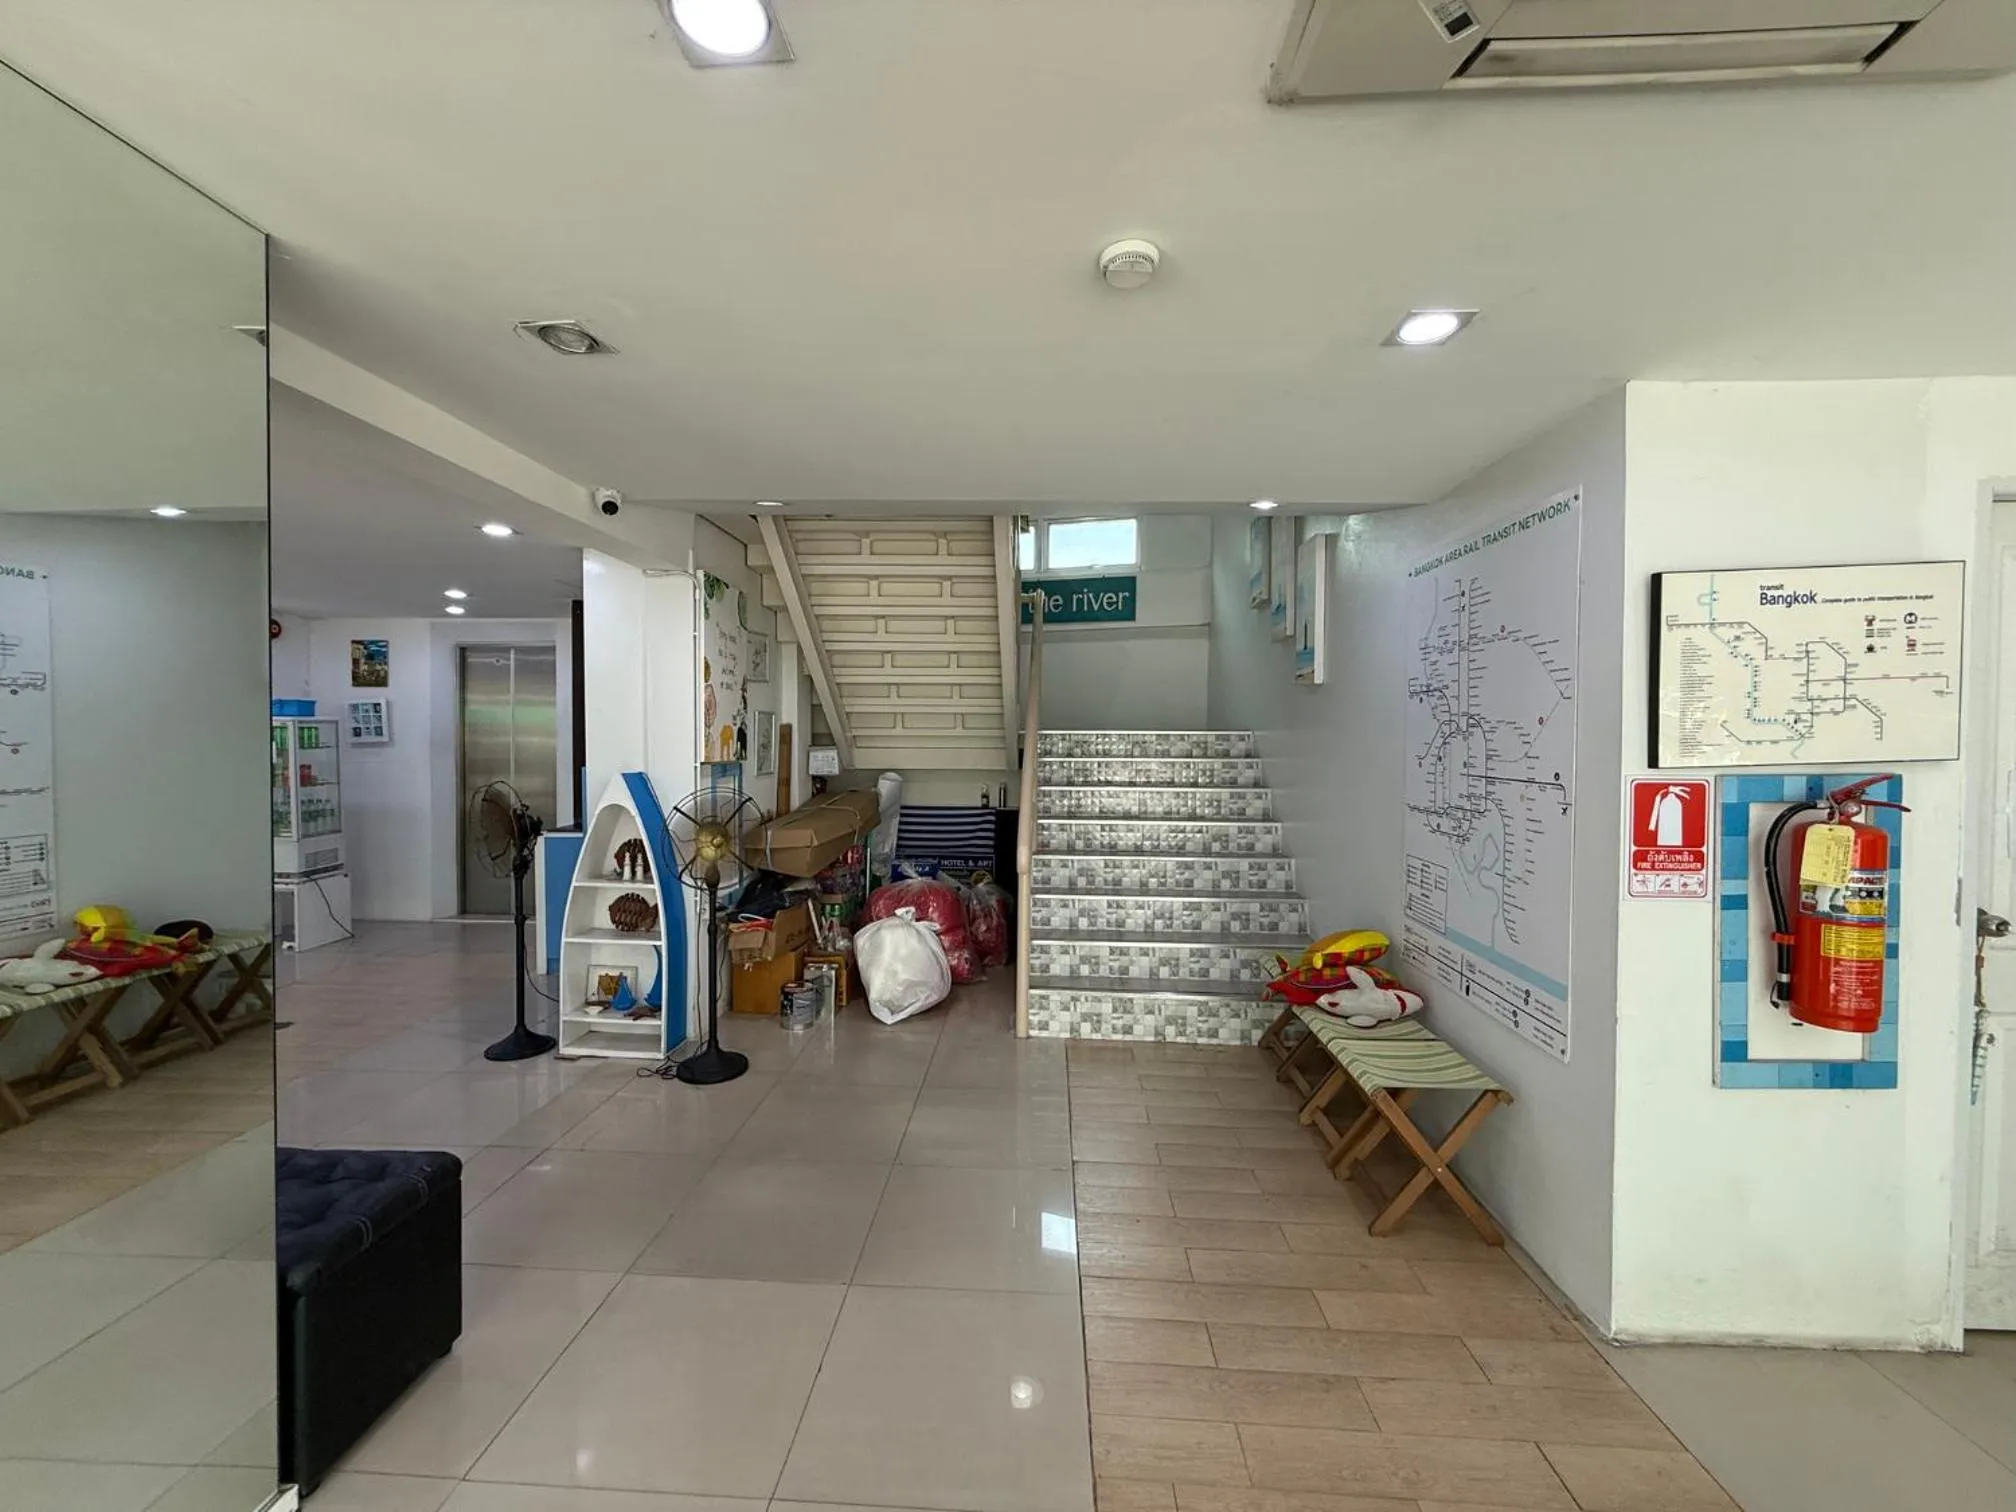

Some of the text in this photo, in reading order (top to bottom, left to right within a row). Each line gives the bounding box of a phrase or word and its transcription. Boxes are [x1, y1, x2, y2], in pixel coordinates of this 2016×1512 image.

[1413, 498, 1571, 578] BANGKOK AREA RAIL TRANSIT NETWORK
[1759, 583, 1784, 591] transit
[1072, 587, 1129, 612] river
[1759, 589, 1818, 608] Bangkok
[940, 859, 966, 867] HOTEL
